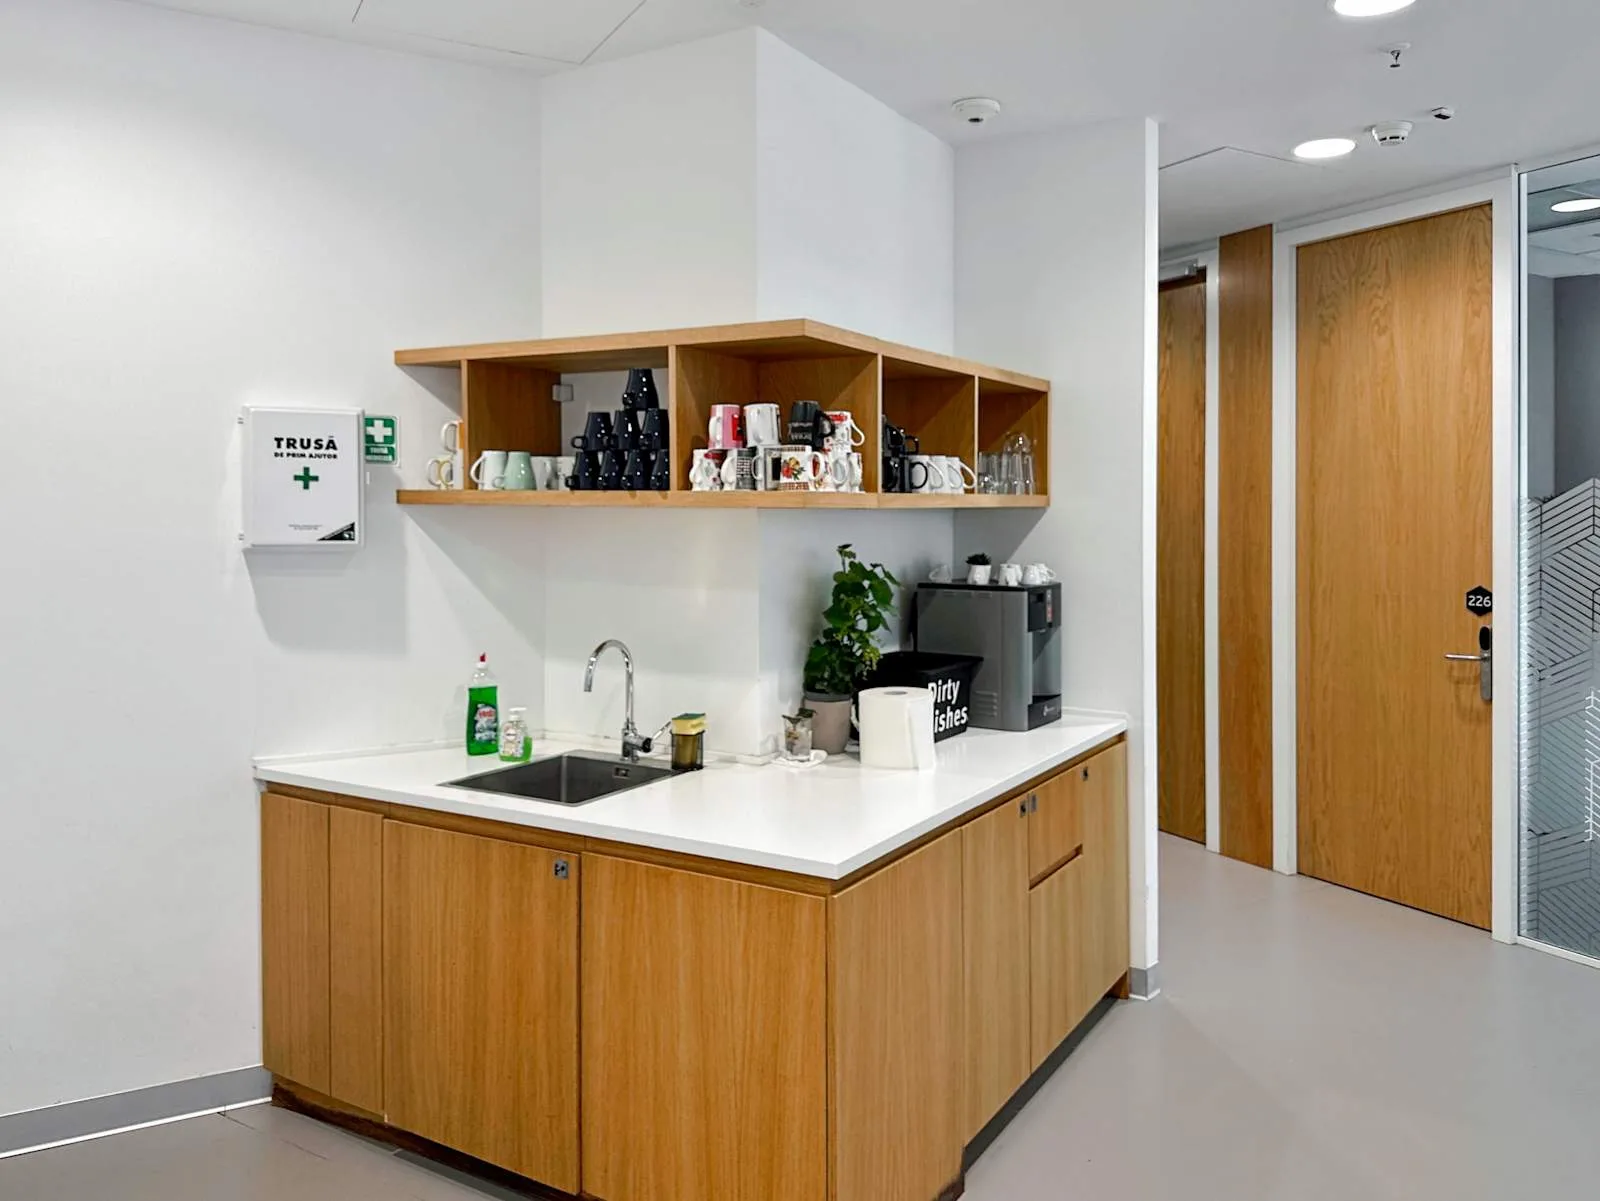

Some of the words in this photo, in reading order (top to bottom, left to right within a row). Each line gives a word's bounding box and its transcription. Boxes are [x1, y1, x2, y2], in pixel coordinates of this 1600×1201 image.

[1468, 595, 1491, 607] 226
[928, 679, 961, 705] Dirty
[934, 706, 968, 733] ishes
